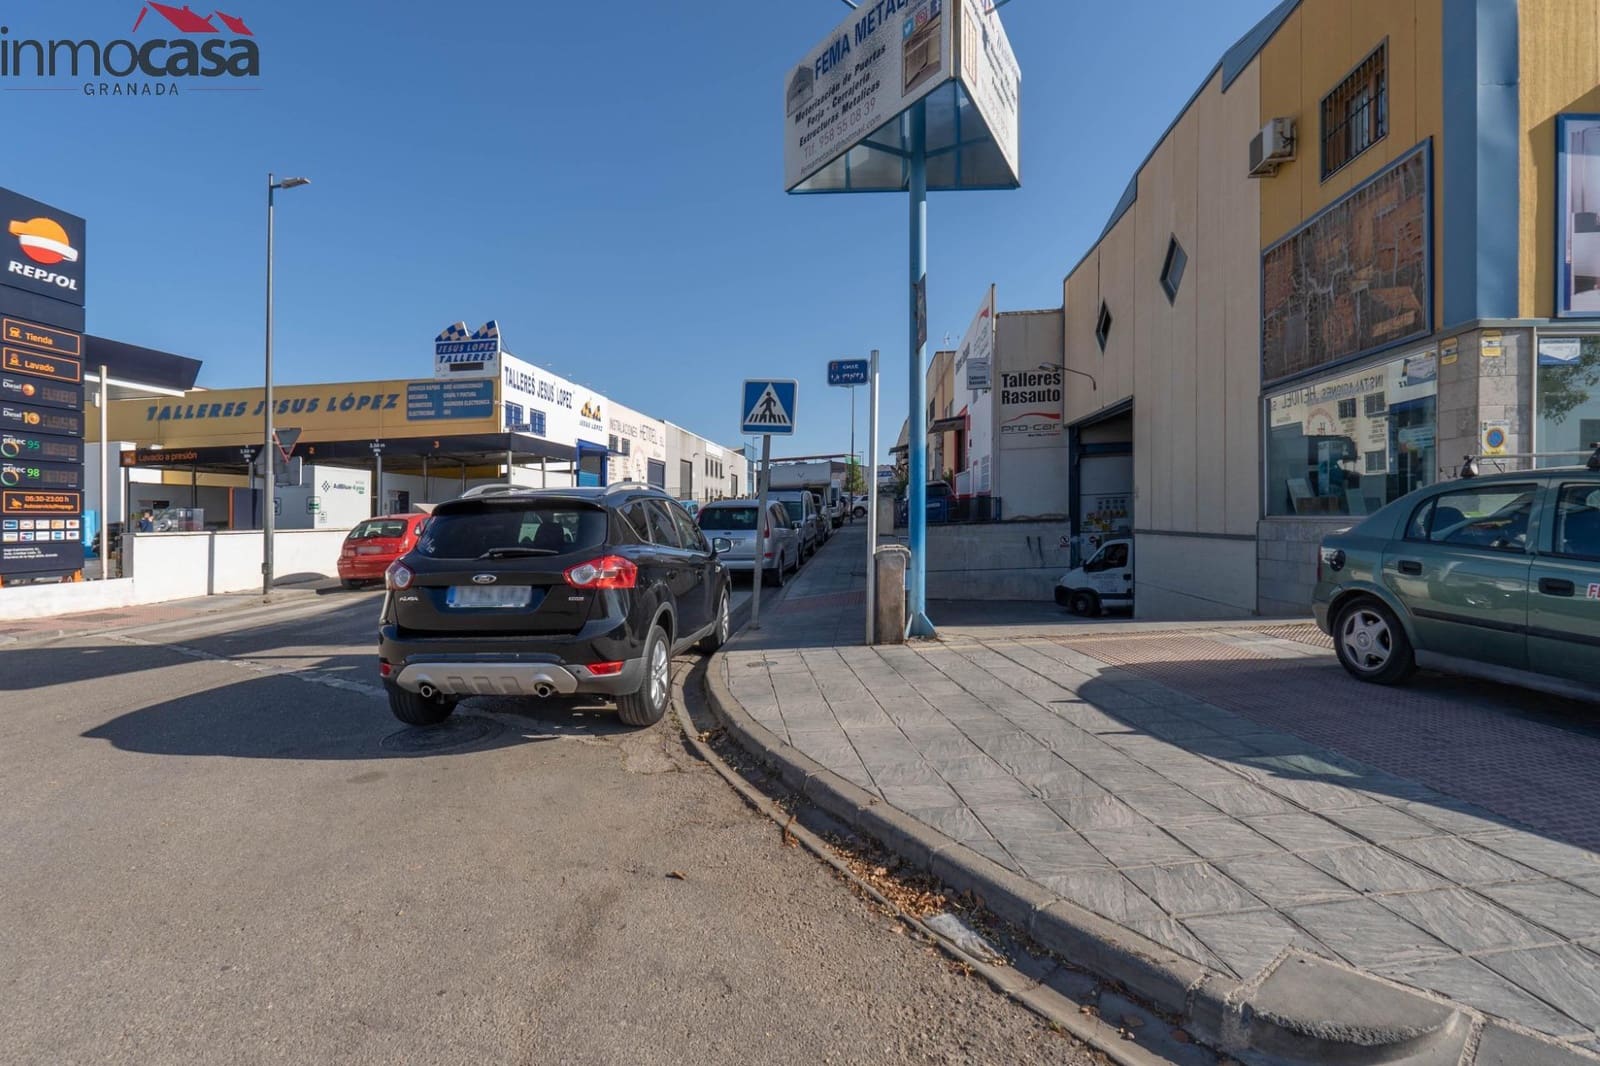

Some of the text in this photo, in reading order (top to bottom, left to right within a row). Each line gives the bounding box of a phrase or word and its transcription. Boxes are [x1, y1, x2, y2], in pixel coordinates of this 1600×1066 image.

[815, 33, 850, 80] FEMA
[842, 73, 852, 86] de
[854, 44, 886, 76] Puertas
[799, 112, 839, 147] Estructuras
[8, 260, 78, 290] REPSOL
[25, 332, 53, 345] Tienda
[438, 342, 496, 354] JESUS LOPEZ
[439, 352, 494, 363] TALLERES
[25, 360, 55, 373] Lavado
[504, 366, 573, 410] TALLERES JESUS LOPEZ
[1001, 372, 1061, 388] Talleres
[1001, 388, 1061, 405] Rasauto
[146, 401, 248, 421] TALLERES
[326, 392, 400, 412] LÓPEZ
[27, 440, 40, 449] 95
[27, 468, 40, 477] 98
